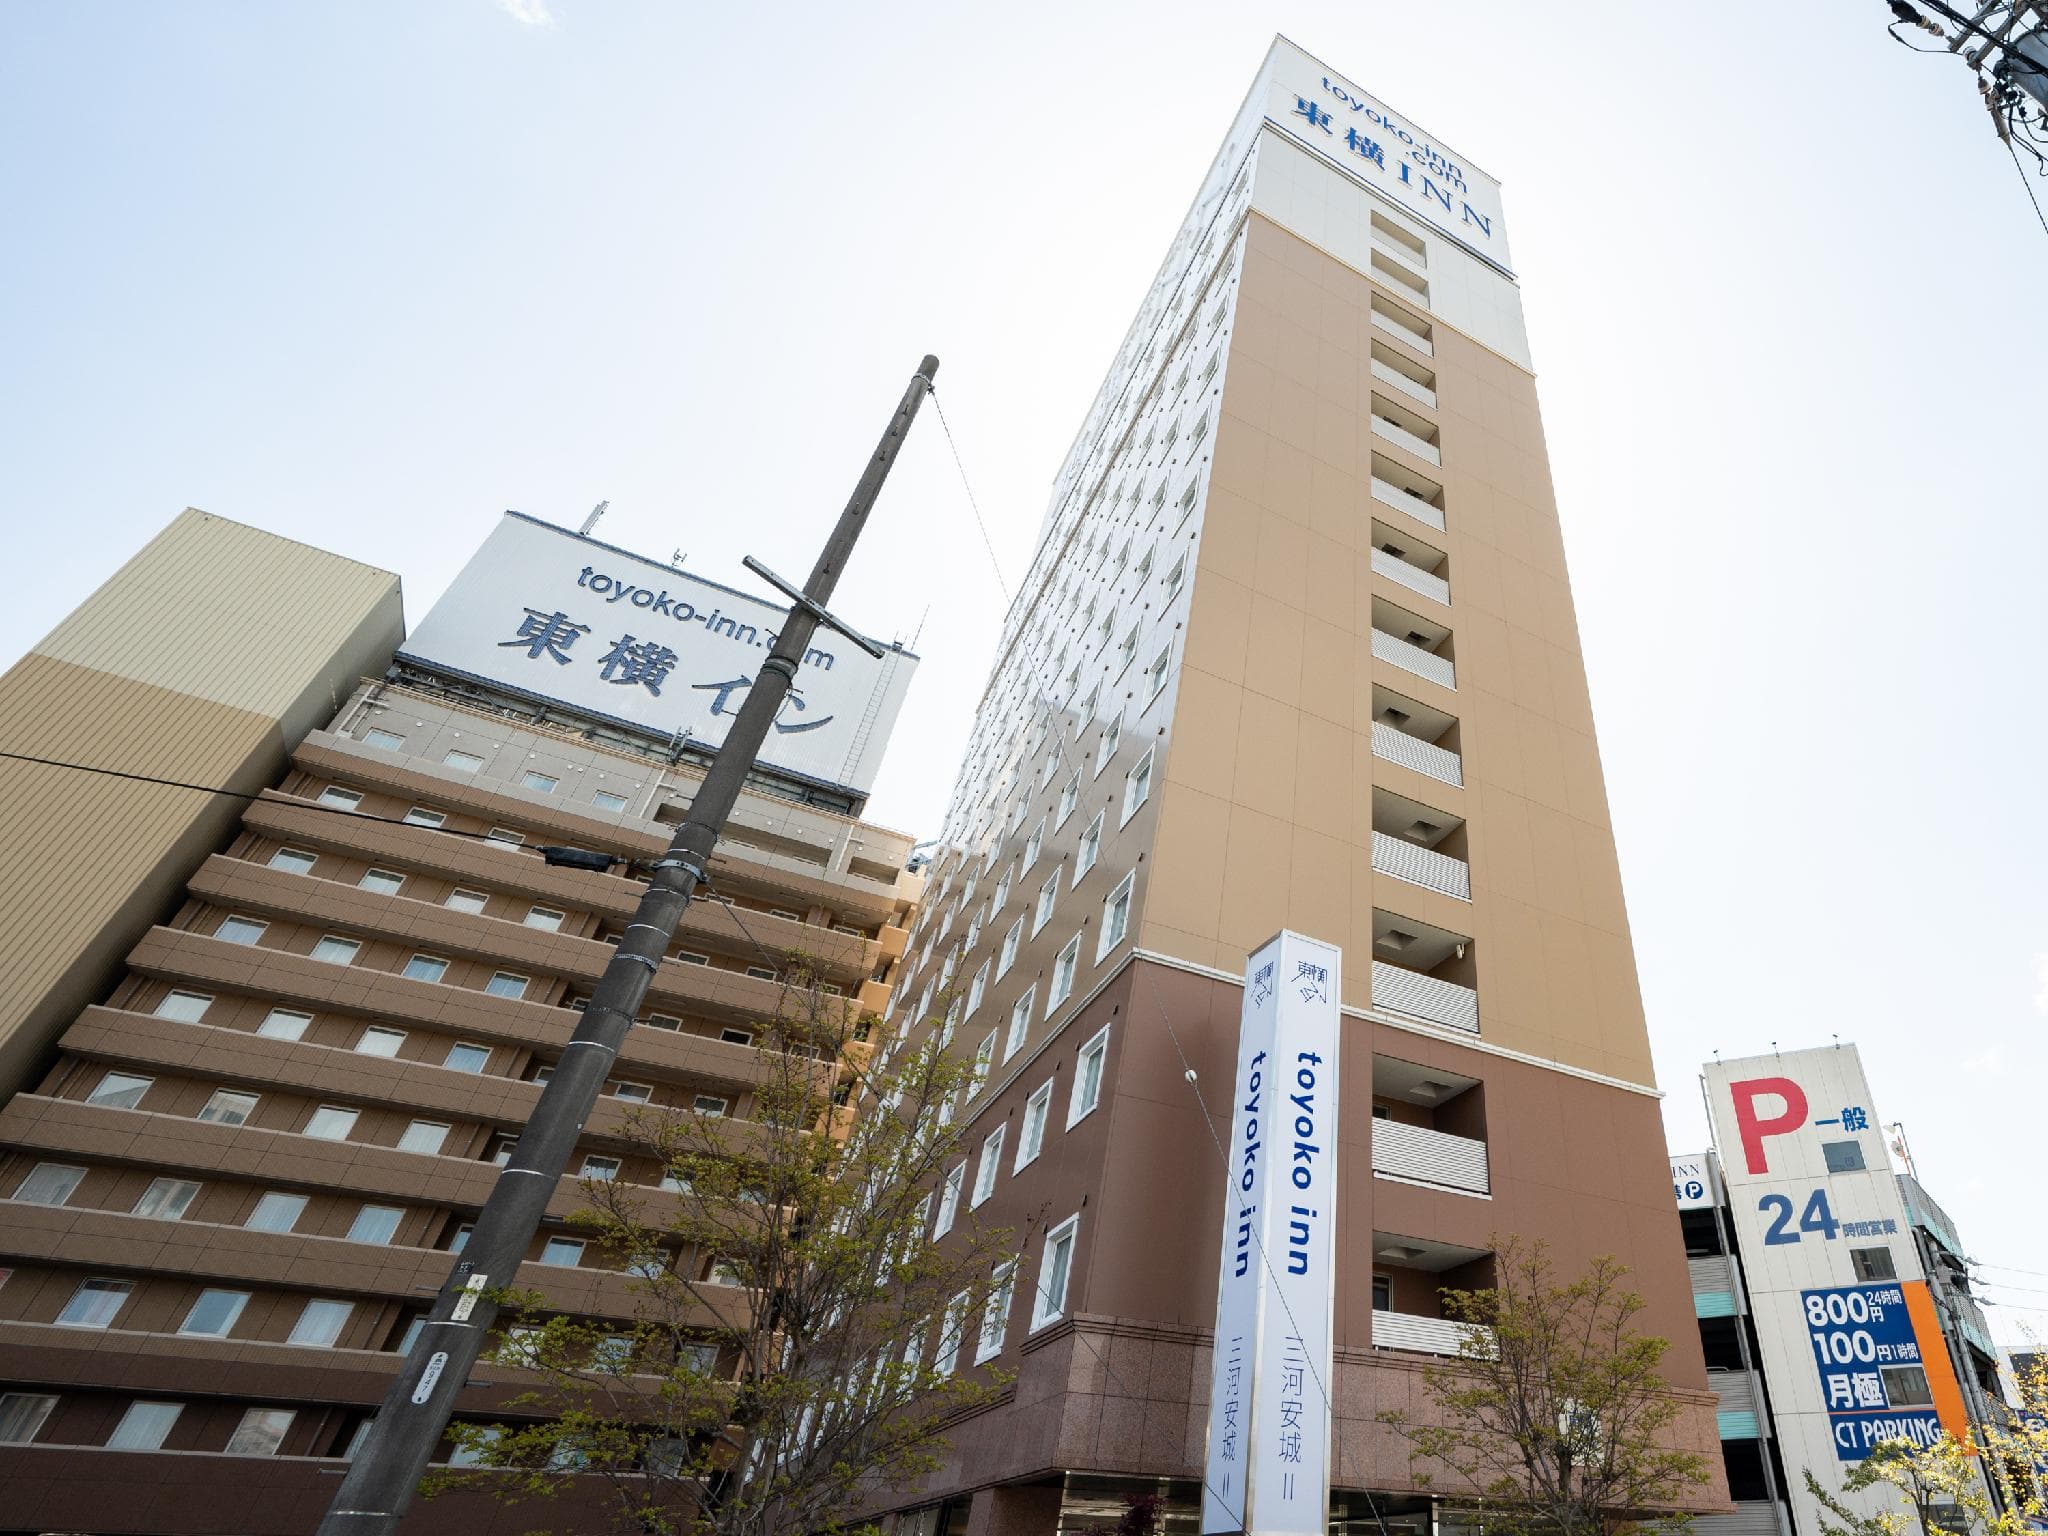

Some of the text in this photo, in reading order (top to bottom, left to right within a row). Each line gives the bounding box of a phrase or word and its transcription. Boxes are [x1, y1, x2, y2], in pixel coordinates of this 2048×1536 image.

[1322, 77, 1463, 179] toyoko-inn
[1406, 151, 1467, 193] .com
[577, 566, 834, 670] toyoko-inn.cm
[1235, 1050, 1267, 1278] toyoko inn
[1287, 1051, 1323, 1277] toyoko inn
[1730, 1077, 1808, 1174] P
[1827, 1372, 1885, 1408] 月極
[1835, 1418, 1941, 1448] CT PARKING
